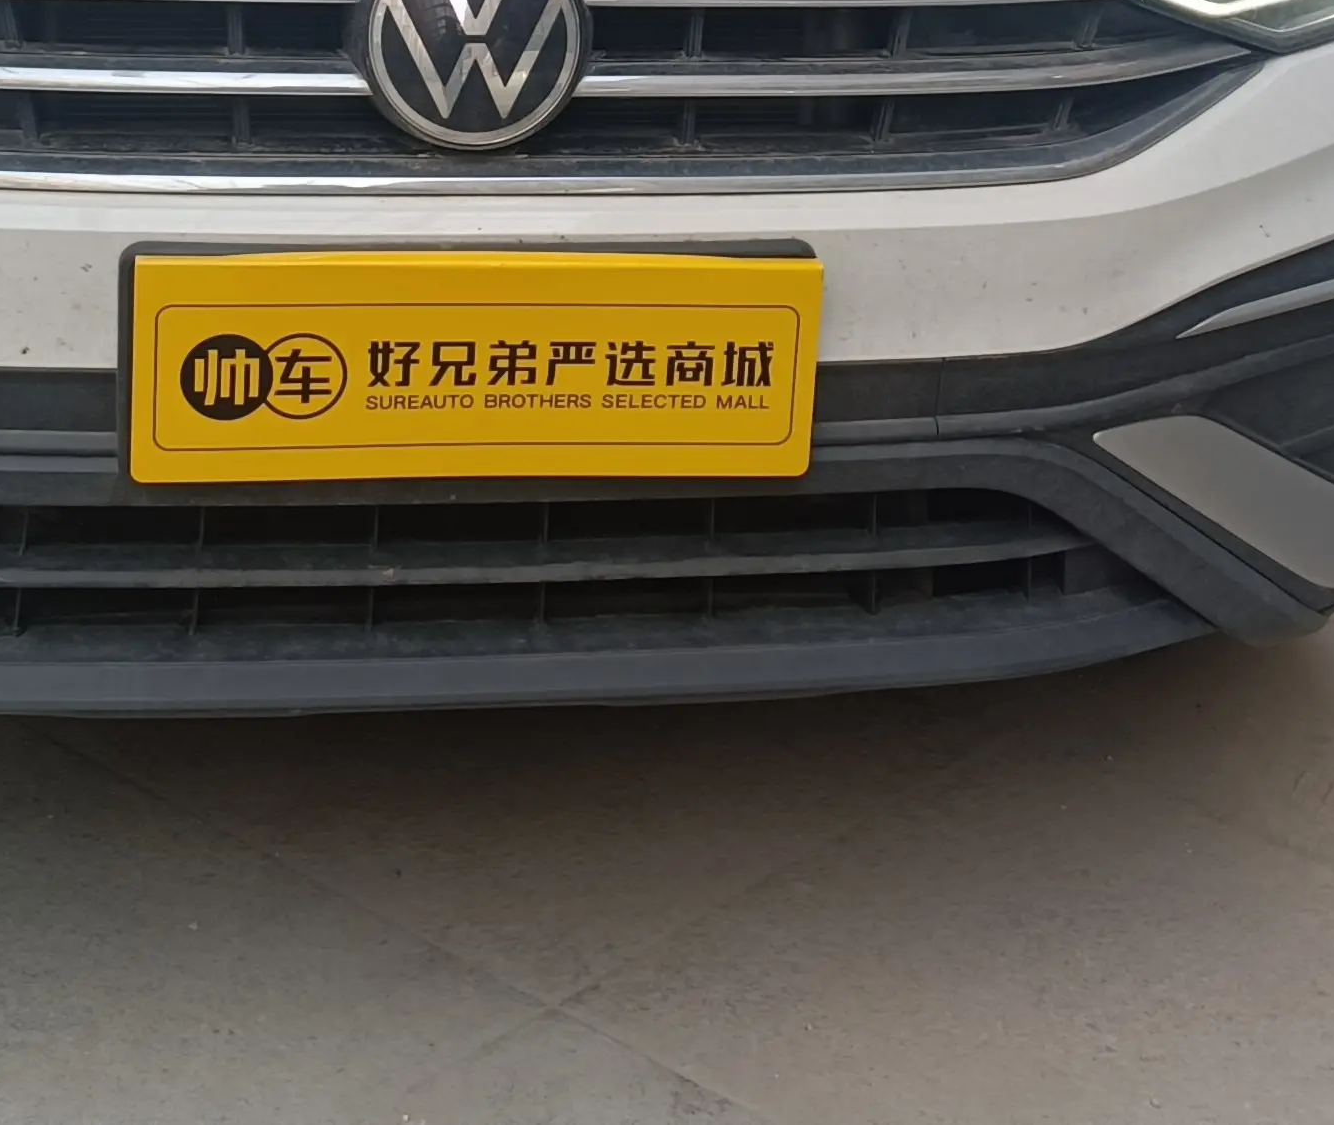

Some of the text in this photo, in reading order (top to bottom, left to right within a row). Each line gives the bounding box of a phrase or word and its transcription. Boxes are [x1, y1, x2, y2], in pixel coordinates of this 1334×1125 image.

[193, 347, 333, 407] 帅车
[366, 339, 775, 388] 好兄弟严选商城
[365, 393, 770, 411] SUREAUTO BROTHERS SELECTED MALL
